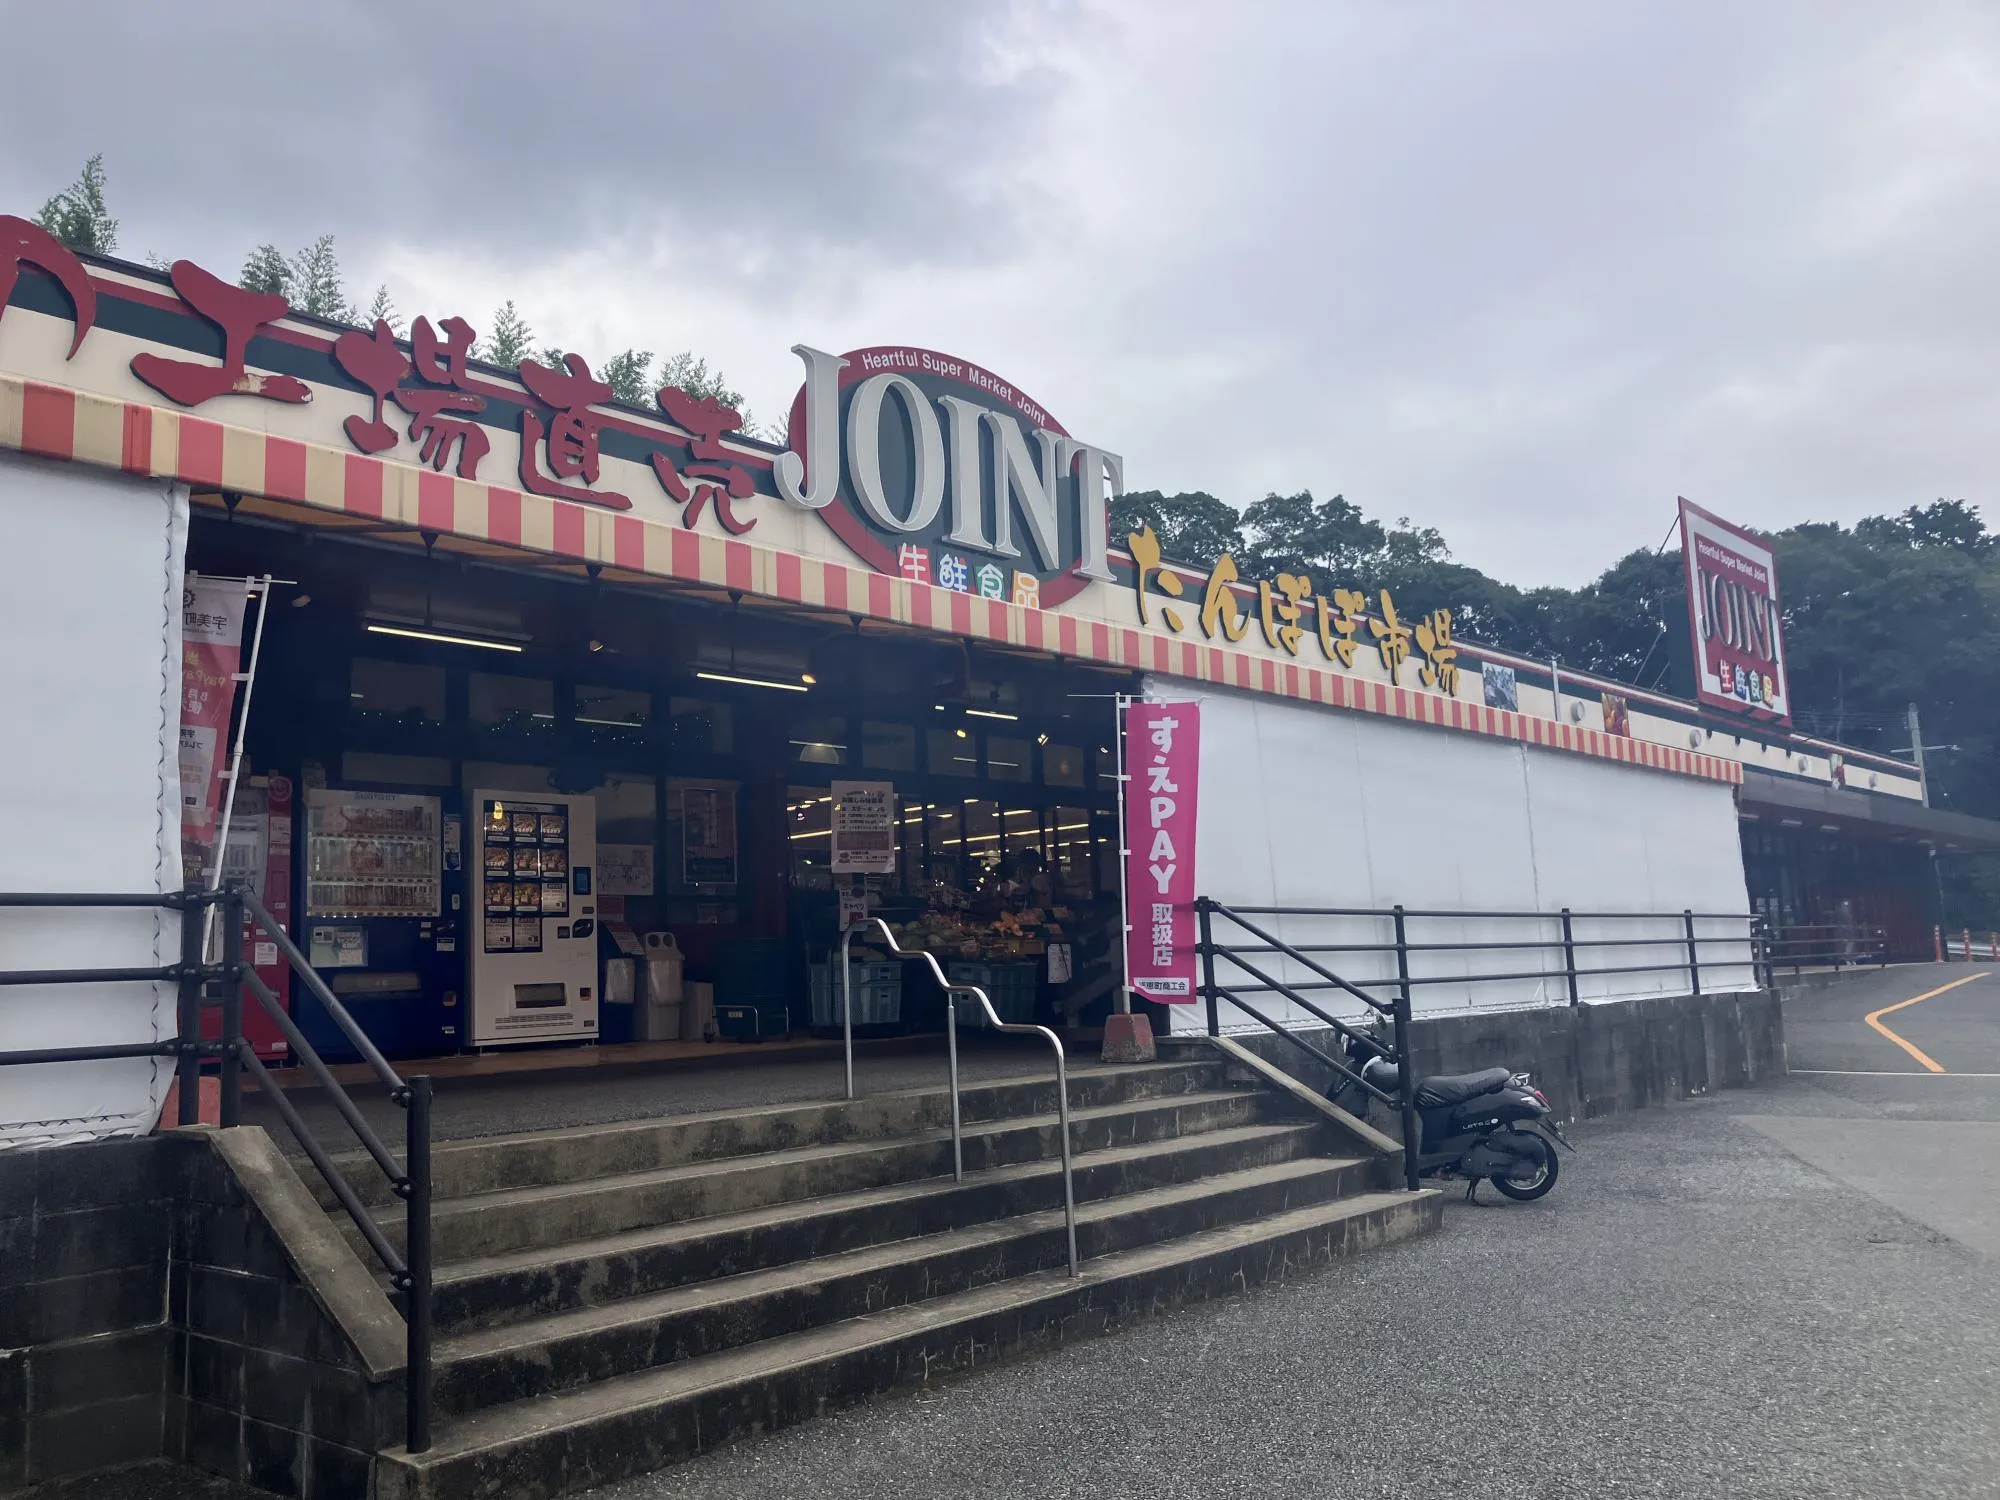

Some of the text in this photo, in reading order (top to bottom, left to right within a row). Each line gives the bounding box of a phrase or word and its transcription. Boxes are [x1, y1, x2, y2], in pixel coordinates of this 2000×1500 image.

[862, 352, 1046, 427] Heartful Super Market Joint
[773, 343, 1124, 583] JOINT
[898, 542, 1040, 609] 生鮮食品
[1128, 524, 1459, 697] たんぽぽ市場
[1698, 566, 1779, 664] JOINT
[1151, 903, 1173, 967] 取扱店
